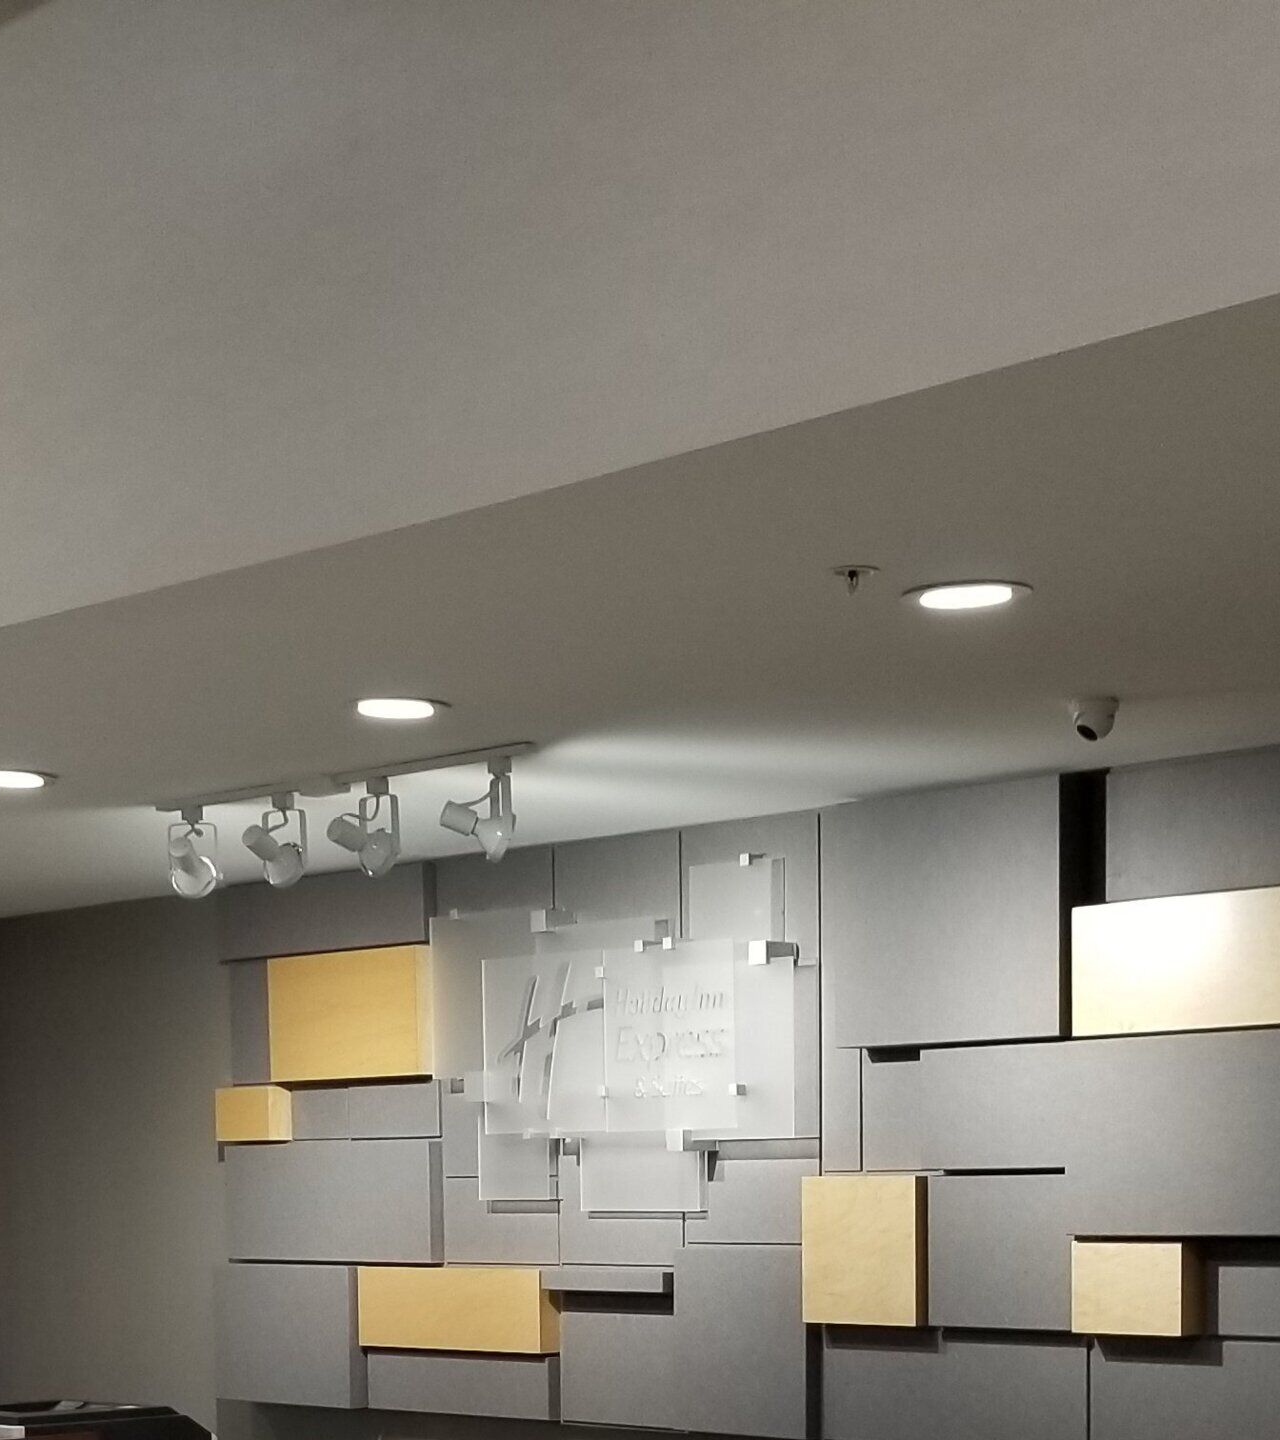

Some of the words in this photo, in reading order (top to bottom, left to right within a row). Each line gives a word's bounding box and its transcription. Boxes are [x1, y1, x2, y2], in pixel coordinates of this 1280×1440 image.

[615, 986, 687, 1018] Holiday
[692, 984, 724, 1010] Inn
[615, 1026, 727, 1067] Express
[650, 1075, 704, 1098] Suites
